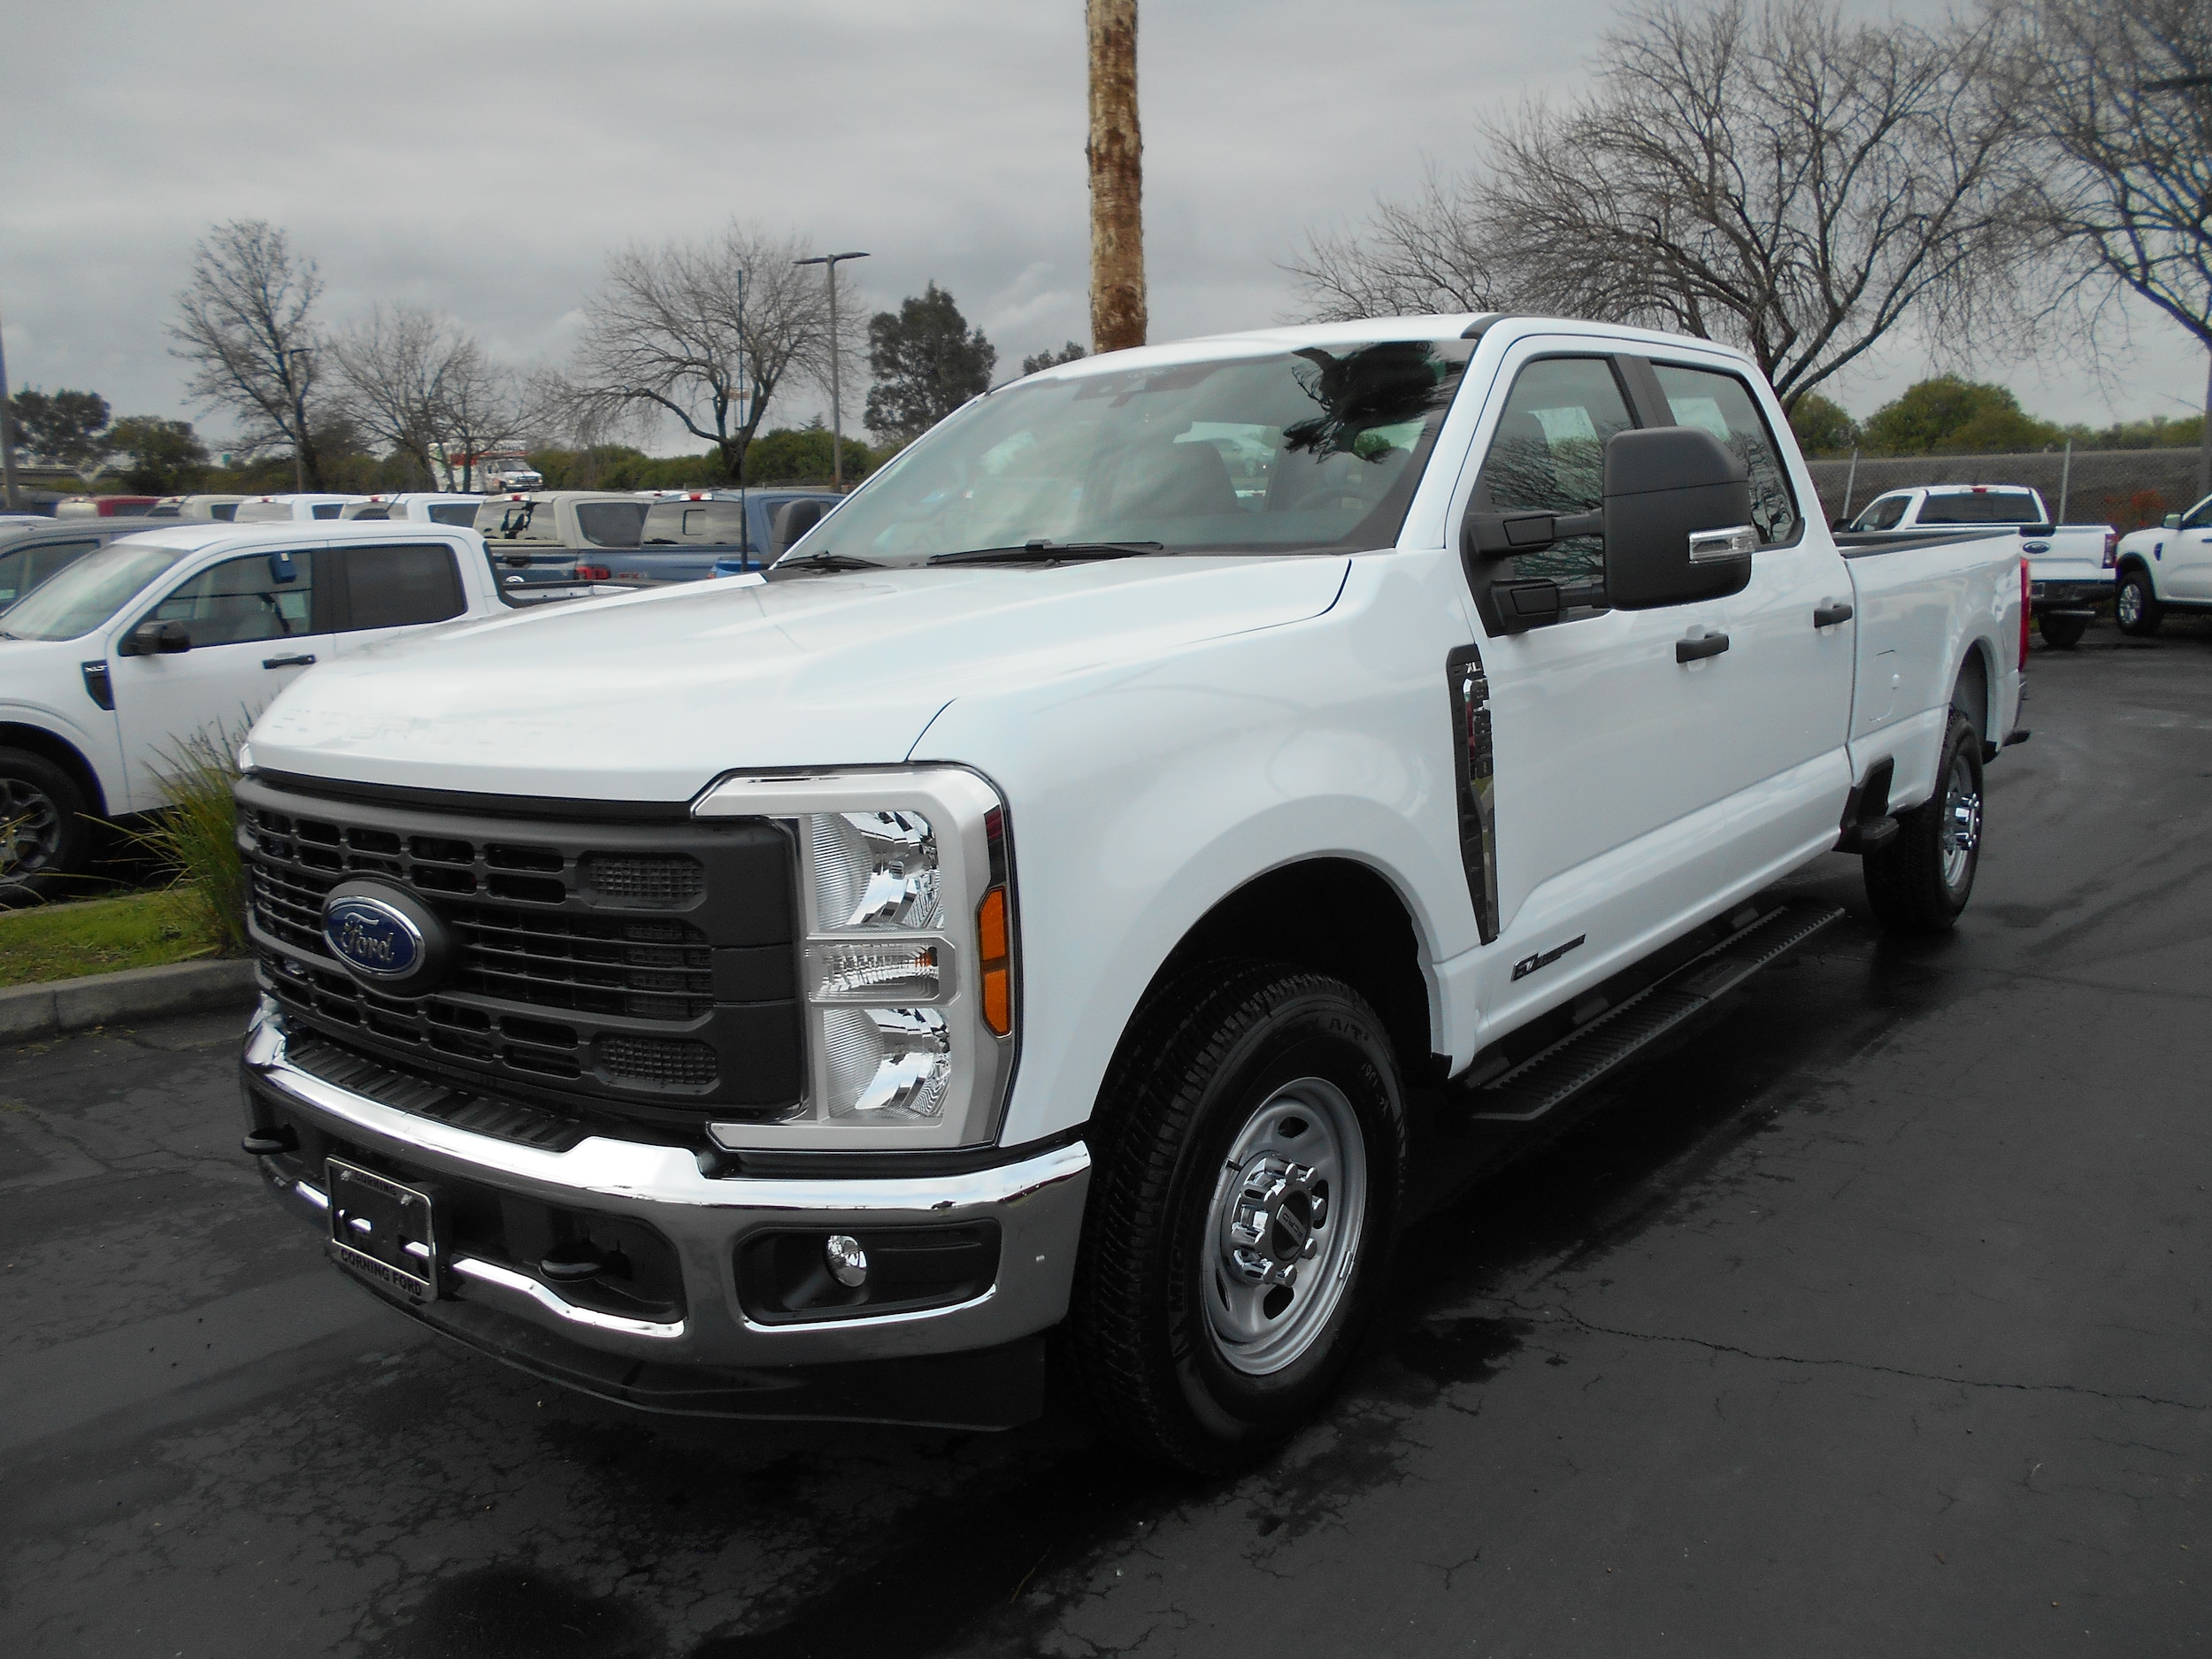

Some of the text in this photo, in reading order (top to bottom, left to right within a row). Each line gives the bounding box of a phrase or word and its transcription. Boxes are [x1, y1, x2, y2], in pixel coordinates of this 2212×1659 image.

[1465, 662, 1481, 673] XL
[341, 912, 395, 962] Ford
[341, 1248, 422, 1296] CORNING FORD
